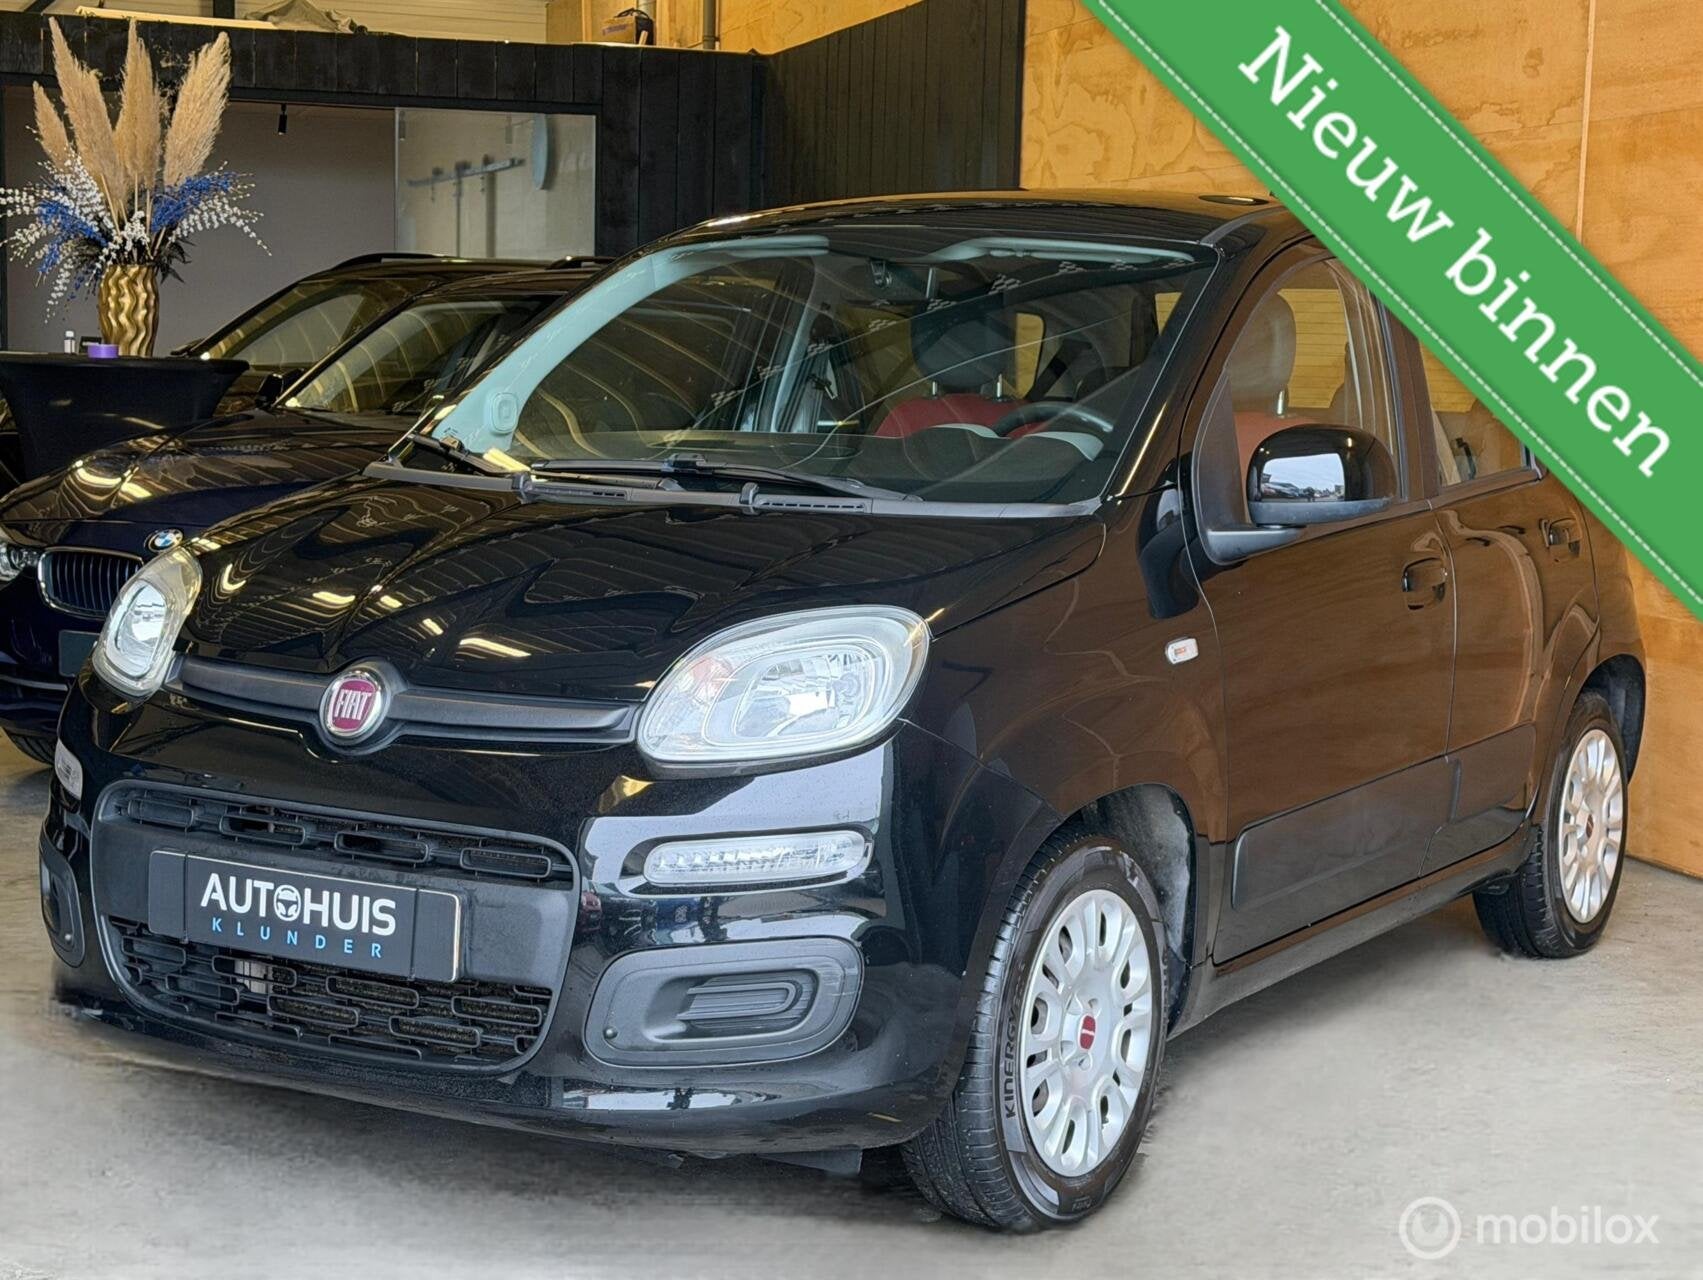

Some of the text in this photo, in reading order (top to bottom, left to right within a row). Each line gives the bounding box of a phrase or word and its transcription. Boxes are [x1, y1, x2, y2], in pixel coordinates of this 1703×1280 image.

[334, 688, 372, 721] FIAT
[200, 872, 397, 937] AUTOHUIS
[211, 916, 383, 959] KLUNDER
[1004, 1007, 1018, 1119] KINERGY
